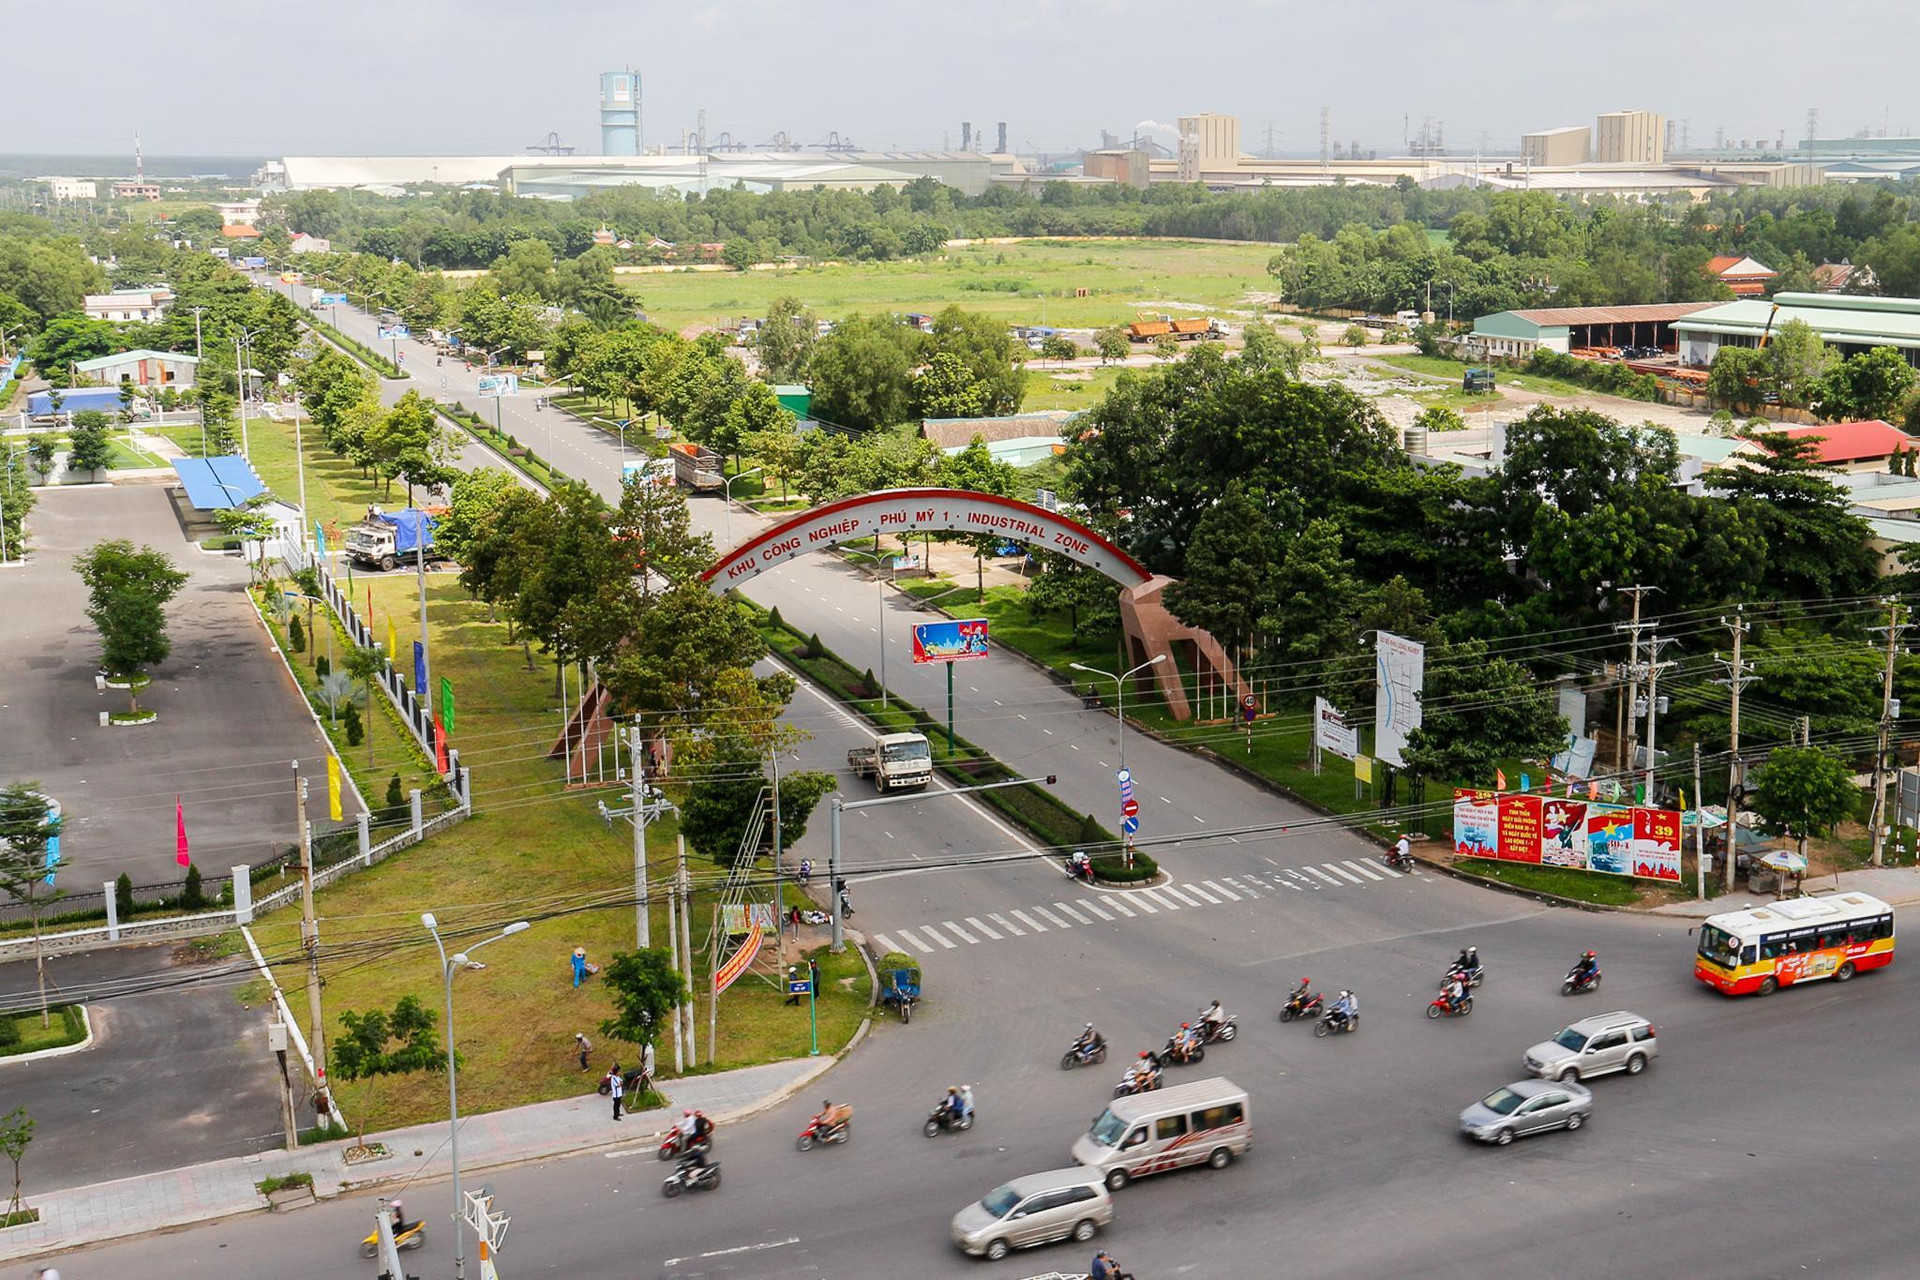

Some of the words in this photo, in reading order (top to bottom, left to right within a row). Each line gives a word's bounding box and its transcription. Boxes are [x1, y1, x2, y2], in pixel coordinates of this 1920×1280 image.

[727, 557, 756, 579] KHU
[762, 537, 801, 561] CÔNG
[808, 519, 860, 542] NGHIỆP
[880, 509, 907, 525] PHÚ
[916, 508, 935, 522] MỸ
[943, 511, 949, 521] 1
[967, 512, 1046, 538] INDUSTRIAL
[1054, 532, 1090, 555] ZONE
[1654, 825, 1673, 836] 39
